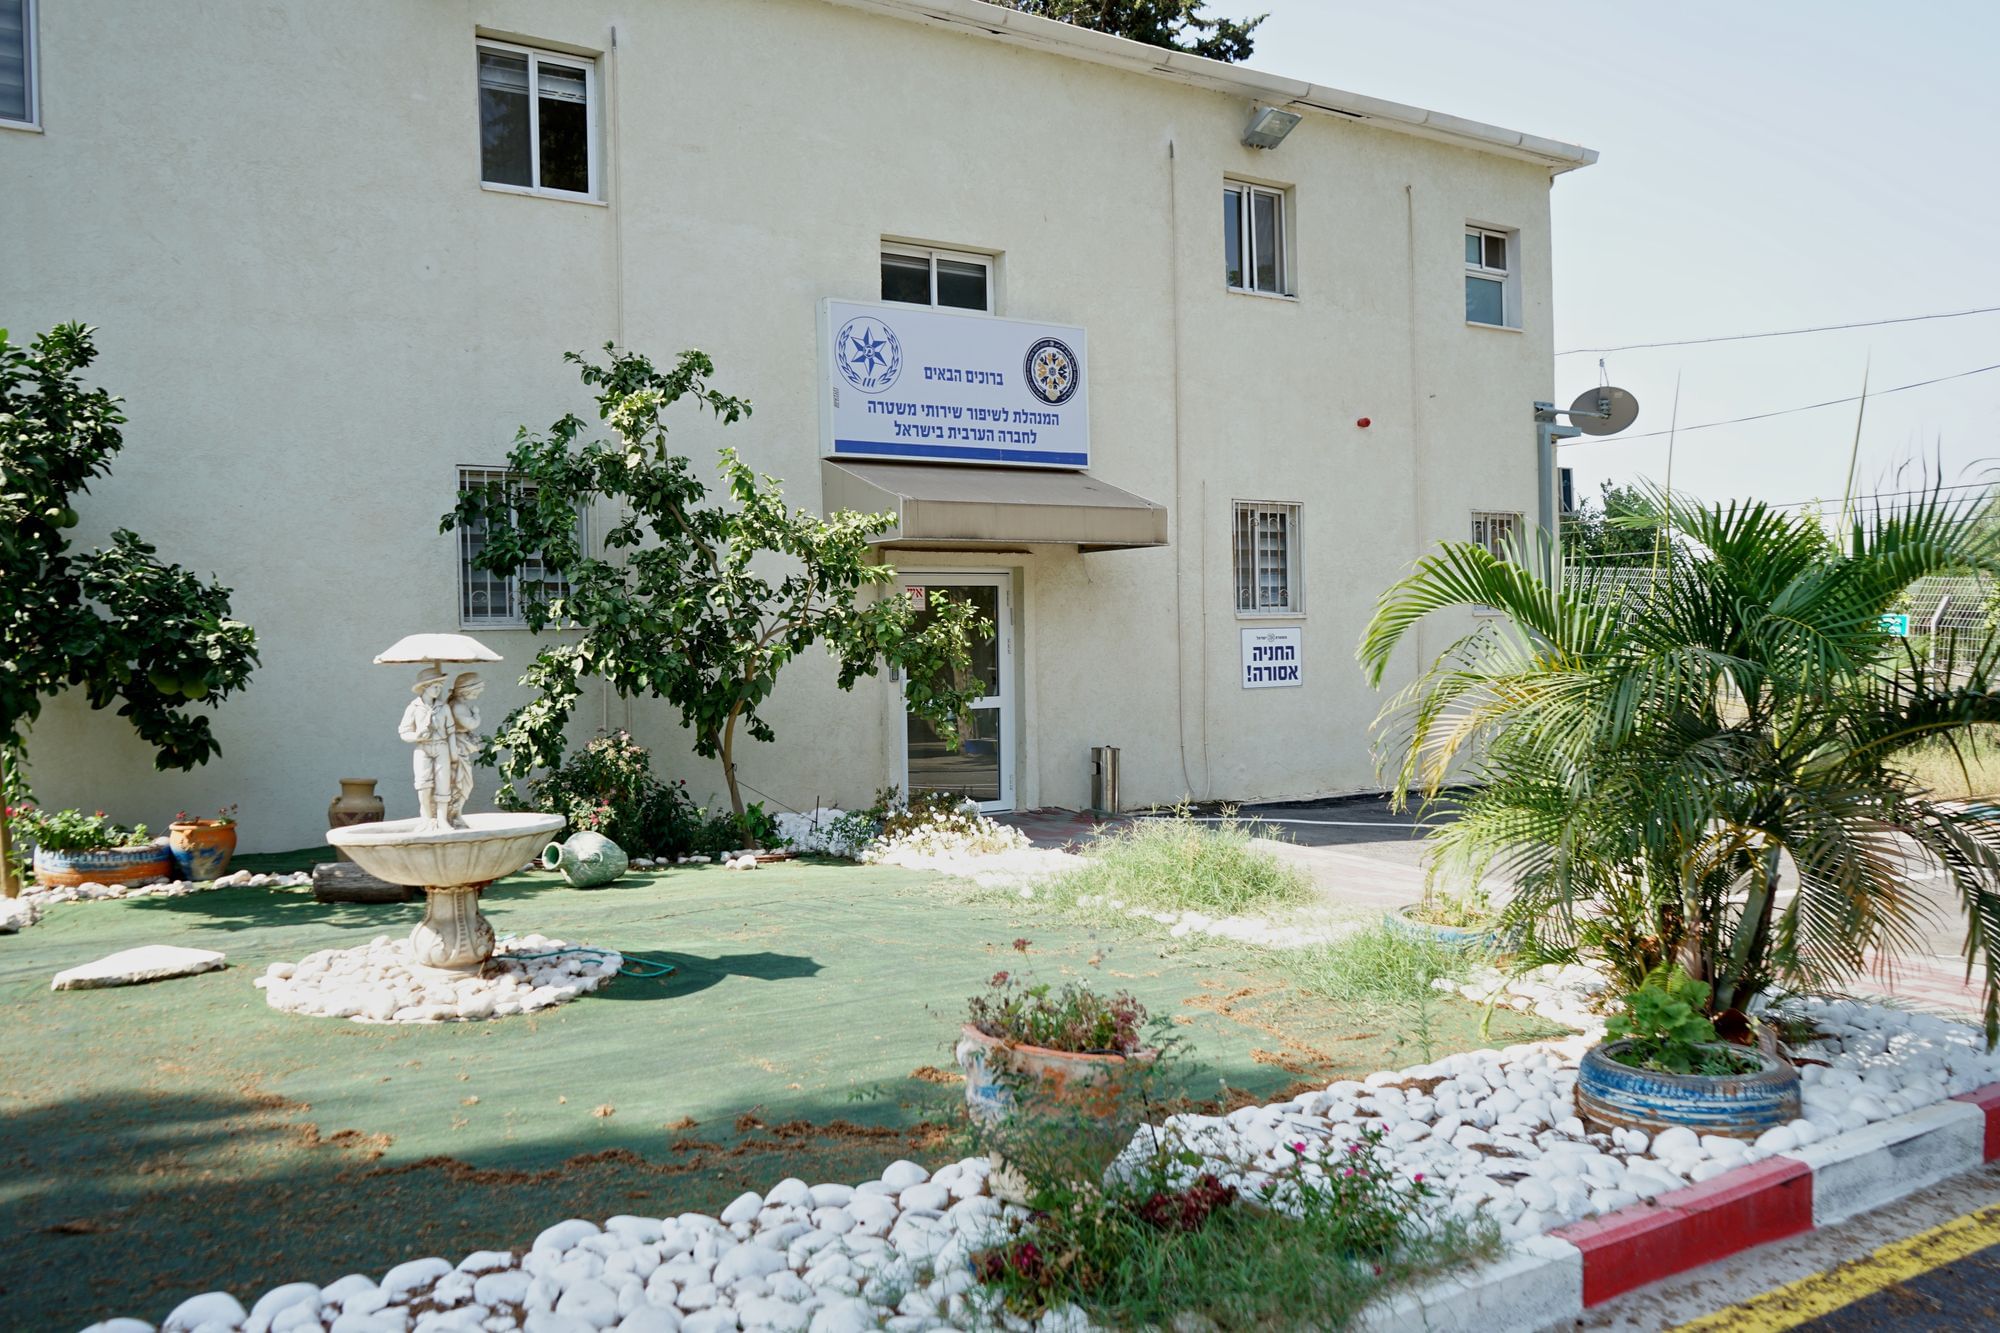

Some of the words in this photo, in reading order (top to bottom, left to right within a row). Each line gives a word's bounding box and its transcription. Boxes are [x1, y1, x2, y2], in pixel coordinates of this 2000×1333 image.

[923, 366, 962, 383] הבאים
[965, 369, 1004, 386] ברוכים
[867, 400, 917, 417] משטרה
[920, 404, 963, 420] שירותי
[966, 407, 1010, 423] לשיפור
[1012, 408, 1060, 426] המנהלת
[893, 419, 945, 439] בישראל
[947, 426, 995, 442] הערבית
[997, 428, 1038, 445] לחברה
[1252, 645, 1295, 662] החניה
[1246, 665, 1299, 683] אסורה!
